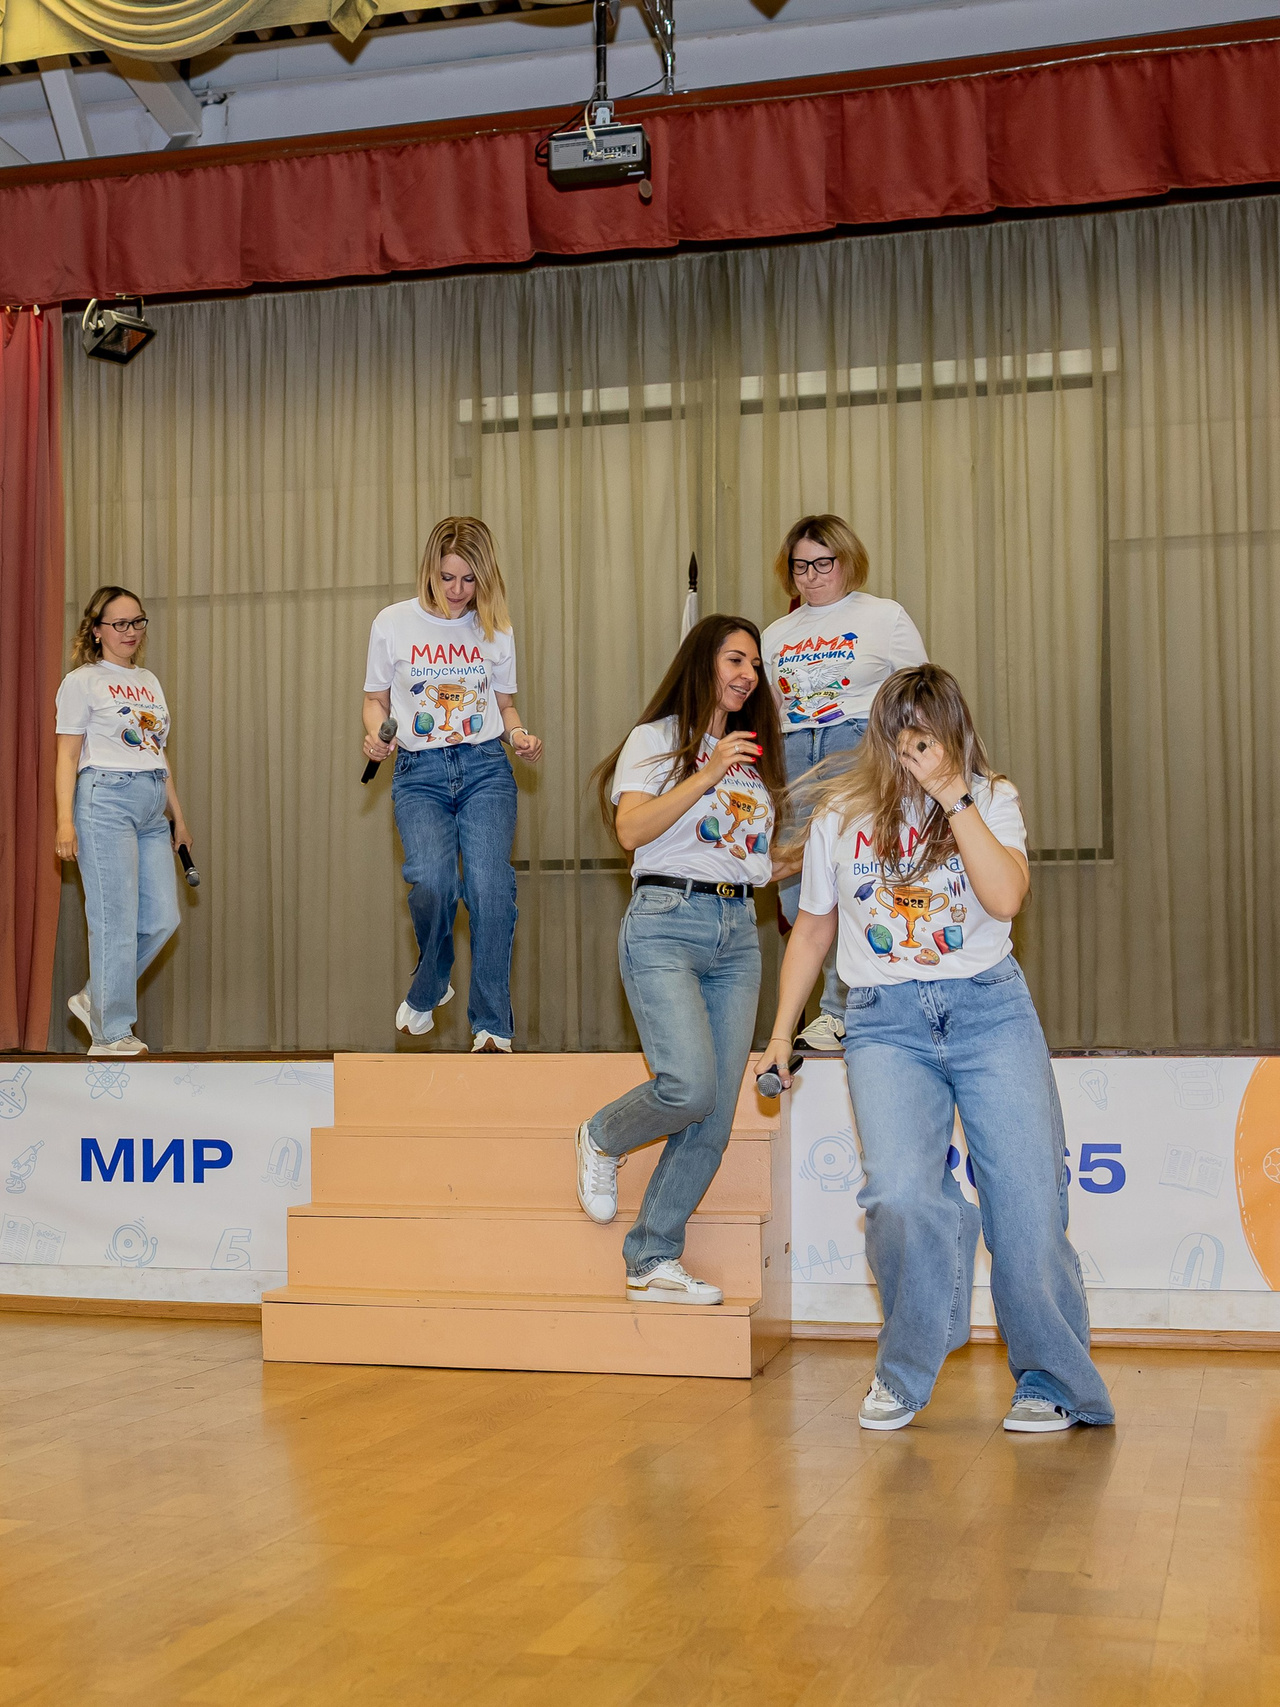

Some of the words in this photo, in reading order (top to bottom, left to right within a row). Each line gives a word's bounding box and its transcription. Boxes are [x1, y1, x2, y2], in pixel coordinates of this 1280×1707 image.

[411, 643, 484, 665] МАМА
[780, 635, 854, 657] МАМА
[777, 650, 856, 668] ВЫПУСКНИКА
[439, 692, 460, 702] 2025
[694, 752, 763, 781] ММА
[731, 799, 752, 813] 2025
[855, 826, 960, 860] ММ
[895, 897, 925, 909] 2025
[81, 1138, 234, 1184] МИР
